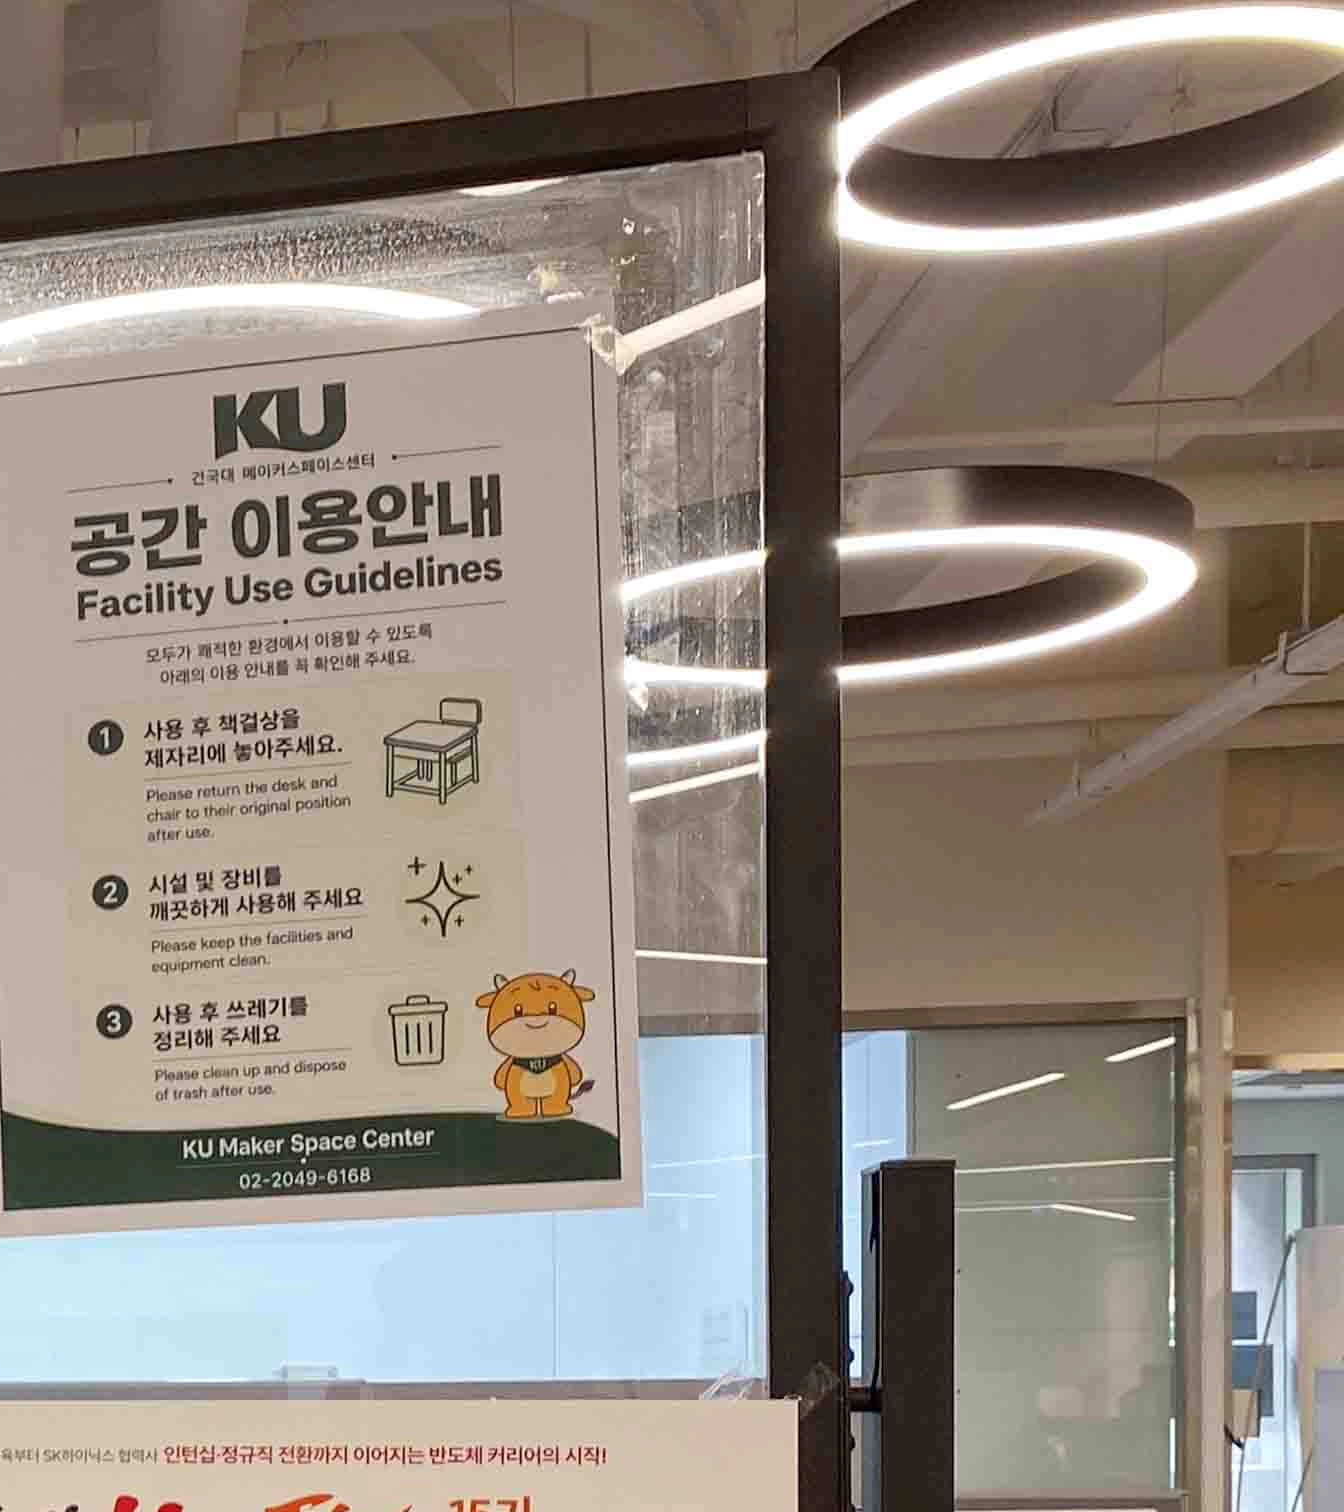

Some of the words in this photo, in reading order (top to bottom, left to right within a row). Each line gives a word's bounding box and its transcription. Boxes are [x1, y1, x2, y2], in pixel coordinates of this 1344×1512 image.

[213, 382, 346, 460] KU
[192, 467, 234, 486] 건국대
[243, 453, 374, 480] 메이커스페이스센터
[71, 504, 207, 576] 공간
[231, 473, 501, 560] 이용안내
[78, 581, 214, 620] Facility
[225, 574, 293, 605] Use
[304, 555, 502, 598] Guidelines
[144, 719, 183, 741] 사용
[192, 717, 211, 738] 후
[219, 708, 300, 734] 책걸상을
[145, 744, 225, 768] 제자리에
[146, 789, 193, 802] Please
[197, 785, 240, 799] return
[245, 782, 267, 794] the
[272, 776, 306, 792] desk
[311, 774, 338, 789] and
[148, 829, 182, 842] after
[185, 827, 214, 840] use.
[149, 872, 187, 895] 시설
[196, 871, 213, 892] 및
[222, 866, 281, 890] 장비를
[150, 896, 228, 920] 깨끗하게
[236, 891, 295, 914] 사용해
[304, 888, 363, 911] 주세요
[153, 1004, 192, 1024] 사용
[200, 1002, 219, 1022] 후
[227, 996, 307, 1019] 쓰레기를
[154, 1028, 213, 1051] 정리해
[221, 1024, 280, 1047] 주세요
[184, 1139, 213, 1159] KU
[220, 1136, 284, 1157] Maker
[292, 1135, 356, 1155] Space
[363, 1128, 434, 1148] Center
[240, 1167, 370, 1189] 02-2049-6168
[41, 1448, 114, 1464] SK하이닉스
[119, 1448, 157, 1464] 협력사
[279, 1445, 347, 1464] 전환까지
[354, 1446, 424, 1464] 이어지는
[430, 1446, 482, 1464] 반도체
[488, 1446, 559, 1465] 커리어의
[566, 1447, 606, 1465] 시작!
